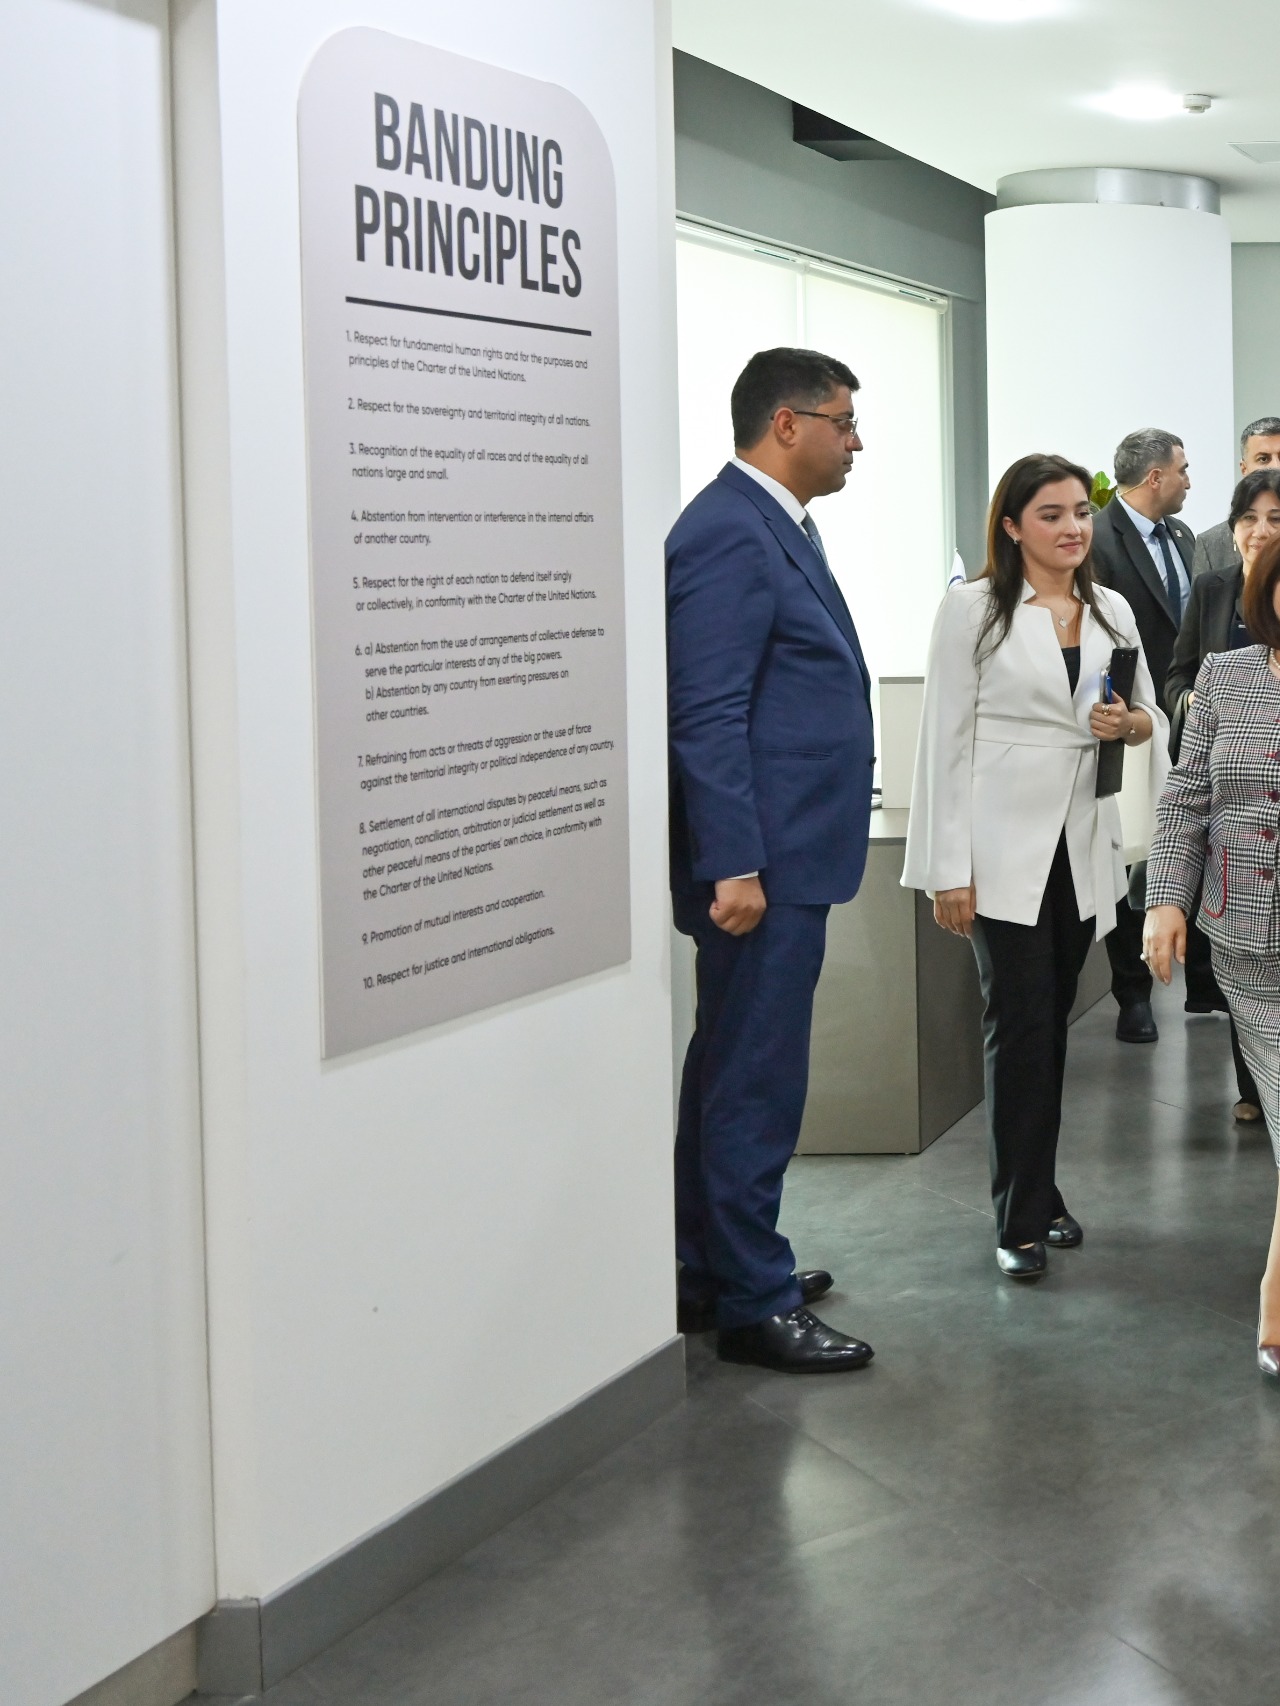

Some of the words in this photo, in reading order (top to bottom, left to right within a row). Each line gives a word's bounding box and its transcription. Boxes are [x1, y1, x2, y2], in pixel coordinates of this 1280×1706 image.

[374, 92, 563, 209] BANDUNG
[354, 184, 582, 298] PRINCIPLES
[345, 329, 351, 342] 1.
[353, 330, 388, 347] Respect
[389, 335, 401, 347] for
[402, 336, 453, 353] fundamental
[455, 343, 481, 356] human
[482, 347, 503, 361] rights
[503, 351, 518, 361] and
[519, 351, 529, 362] for
[530, 353, 542, 364] the
[543, 356, 573, 368] purposes
[574, 359, 588, 369] and
[348, 354, 389, 369] principles
[390, 357, 399, 369] of
[400, 359, 415, 371] the
[416, 359, 447, 374] Charter
[448, 363, 456, 375] of
[457, 365, 471, 376] the
[472, 366, 496, 379] United
[497, 368, 526, 382] Nations.
[347, 397, 355, 409] 2.
[357, 398, 391, 413] Respect
[392, 401, 404, 413] for
[405, 403, 419, 414] the
[421, 406, 466, 420] sovereignty
[467, 408, 482, 419] and
[483, 409, 516, 421] territorial
[517, 412, 546, 426] integrity
[547, 413, 554, 424] of
[555, 414, 564, 424] all
[564, 415, 590, 426] nations.
[350, 510, 358, 521] 4.
[360, 510, 405, 522] Abstention
[407, 510, 425, 522] from
[427, 511, 473, 522] intervention
[474, 513, 482, 522] or
[483, 511, 526, 522] interference
[527, 511, 533, 522] in
[534, 512, 546, 522] the
[547, 511, 572, 522] internal
[573, 511, 594, 522] affairs
[353, 532, 363, 544] of
[364, 532, 397, 544] another
[398, 533, 431, 546] country.
[352, 576, 360, 589] 5.
[362, 576, 396, 590] Respect
[397, 575, 409, 587] for
[410, 575, 424, 586] the
[425, 574, 444, 589] right
[445, 574, 454, 585] of
[455, 574, 474, 585] each
[475, 573, 499, 584] nation
[500, 573, 508, 583] to
[509, 571, 534, 583] defend
[535, 570, 552, 581] itself
[552, 570, 571, 583] singly
[375, 684, 420, 698] Abstention
[421, 682, 431, 695] by
[432, 683, 448, 694] any
[449, 679, 478, 690] country
[479, 676, 496, 687] from
[497, 673, 526, 685] exerting
[527, 670, 559, 684] pressures
[560, 669, 569, 678] on
[365, 709, 388, 722] other
[389, 705, 429, 719] countries.
[357, 755, 363, 767] 7.
[365, 751, 407, 766] Refraining
[408, 748, 427, 759] from
[428, 746, 446, 757] acts
[447, 745, 455, 754] or
[456, 739, 484, 752] threats
[484, 736, 493, 748] of
[493, 732, 532, 749] aggression
[533, 732, 541, 741] or
[542, 729, 553, 739] the
[554, 728, 566, 737] use
[567, 724, 574, 736] of
[575, 724, 591, 734] force
[360, 775, 392, 791] against
[393, 772, 408, 783] the
[409, 764, 445, 781] territorial
[447, 760, 479, 776] integrity
[479, 760, 488, 769] or
[489, 753, 517, 771] political
[519, 747, 567, 763] independence
[568, 743, 575, 755] of
[576, 744, 588, 754] any
[589, 740, 614, 751] country.
[359, 821, 367, 834] 8.
[368, 814, 414, 832] Settlement
[415, 811, 424, 823] of
[425, 808, 435, 821] all
[437, 799, 485, 819] international
[486, 796, 516, 810] disputes
[517, 793, 526, 805] by
[527, 785, 557, 804] peaceful
[558, 784, 582, 795] means,
[583, 778, 598, 791] such
[598, 779, 607, 787] as
[361, 837, 412, 857] negotiation,
[414, 828, 461, 845] conciliation,
[462, 819, 501, 835] arbitration
[502, 817, 510, 827] or
[511, 809, 537, 828] judicial
[538, 803, 573, 819] settlement
[574, 802, 582, 812] as
[583, 797, 596, 809] well
[596, 798, 605, 807] as
[362, 865, 385, 878] other
[386, 854, 422, 876] peaceful
[424, 851, 450, 864] means
[451, 846, 460, 858] of
[460, 845, 474, 856] the
[503, 836, 518, 847] own
[519, 830, 544, 843] choice,
[545, 827, 551, 837] in
[552, 820, 587, 836] conformity
[588, 815, 602, 827] with
[362, 888, 378, 900] the
[378, 881, 412, 896] Charter
[412, 876, 421, 888] of
[422, 874, 436, 886] the
[437, 867, 463, 883] United
[463, 862, 494, 876] Nations.
[361, 932, 368, 945] 9.
[370, 924, 412, 943] Promotion
[413, 918, 422, 932] of
[423, 911, 451, 928] mutual
[452, 905, 484, 921] interests
[484, 899, 500, 913] and
[500, 889, 545, 908] cooperation.
[362, 976, 375, 989] 10.
[376, 967, 410, 986] Respect
[411, 964, 423, 975] for
[423, 957, 449, 975] justice
[450, 949, 466, 964] and
[467, 935, 513, 958] international
[514, 926, 555, 945] obligations.
